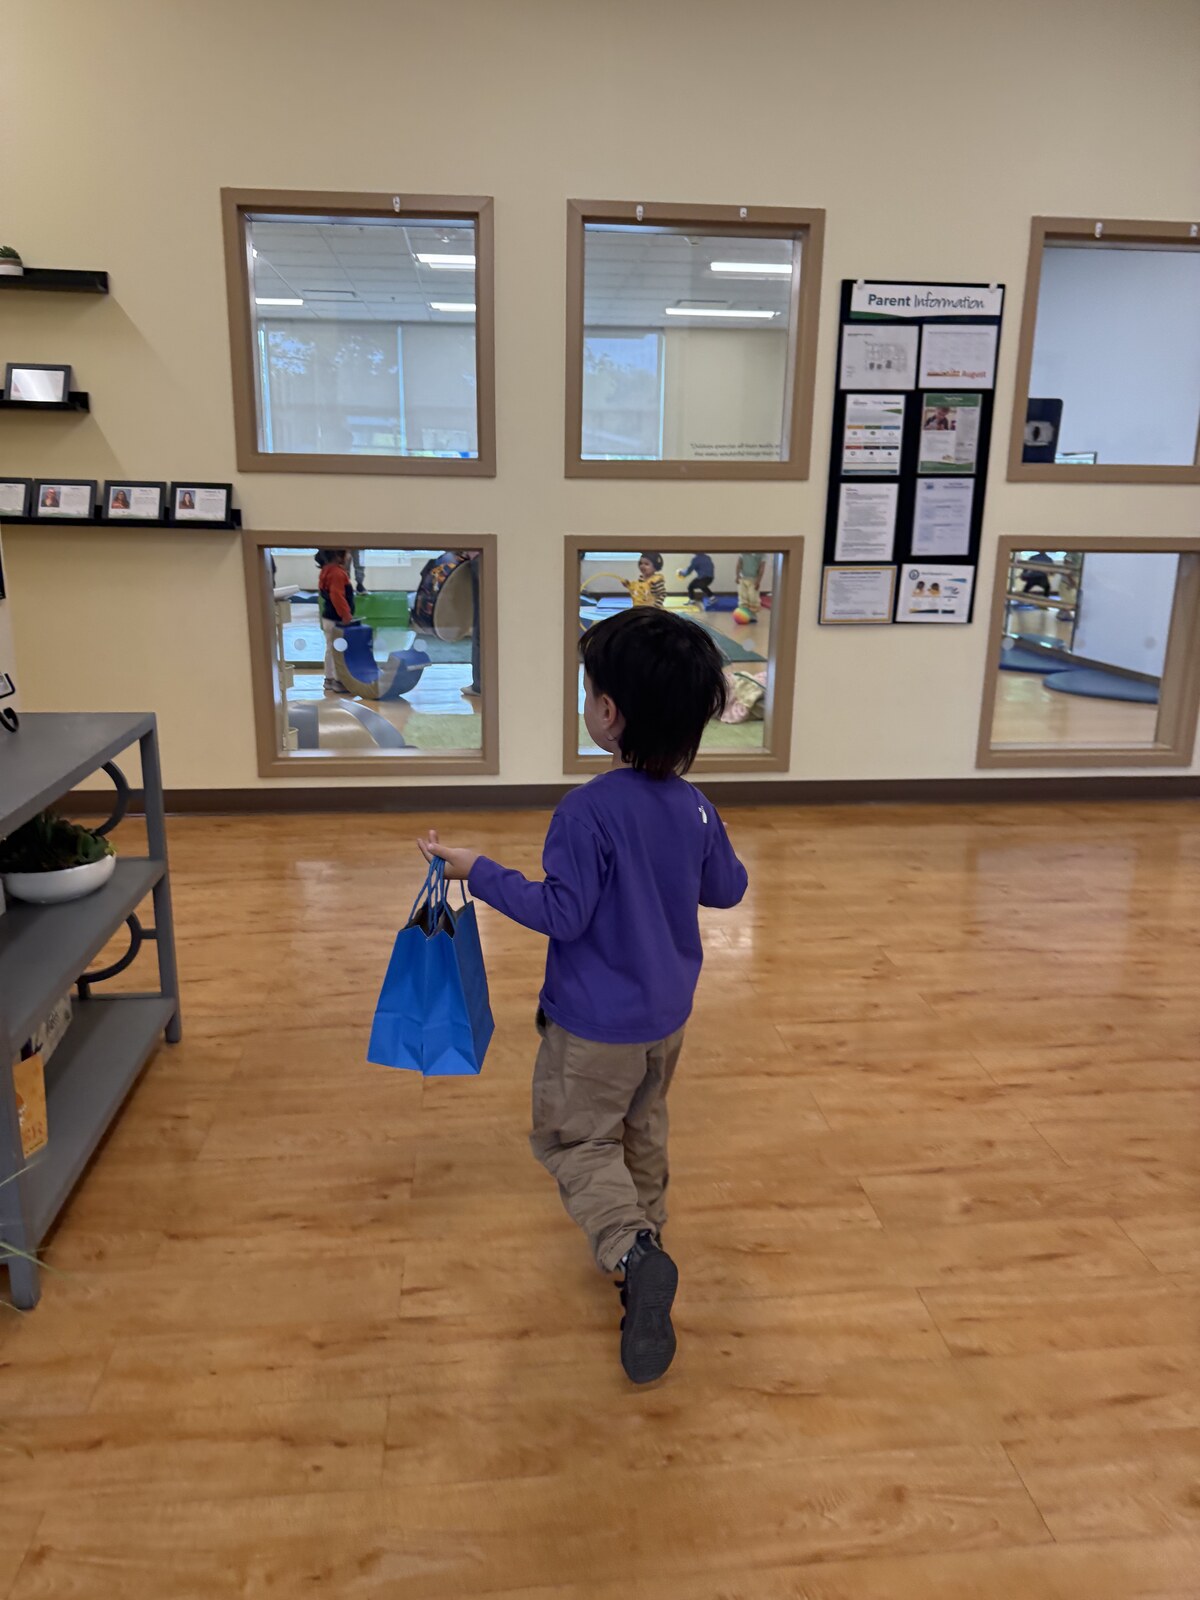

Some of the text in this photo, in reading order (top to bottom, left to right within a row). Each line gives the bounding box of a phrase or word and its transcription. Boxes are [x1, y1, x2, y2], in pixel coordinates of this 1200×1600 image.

[868, 291, 985, 310] Parent Information
[961, 370, 987, 379] August
